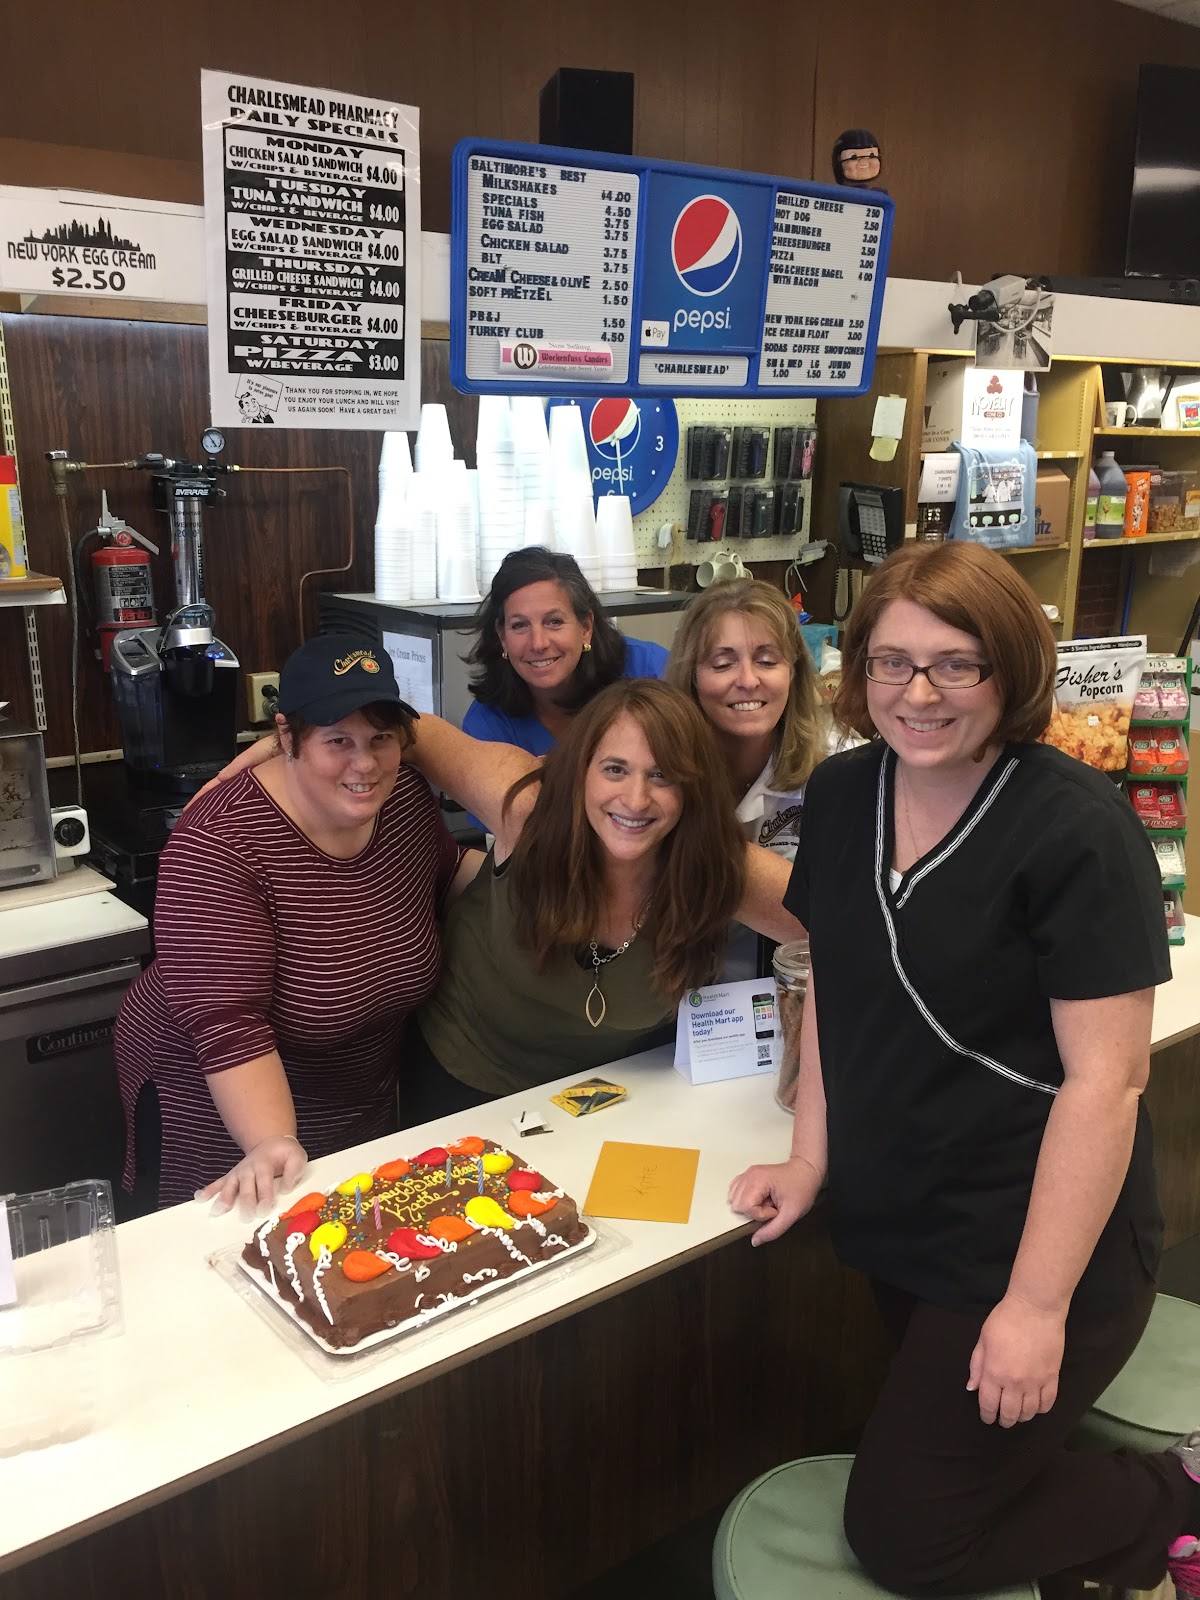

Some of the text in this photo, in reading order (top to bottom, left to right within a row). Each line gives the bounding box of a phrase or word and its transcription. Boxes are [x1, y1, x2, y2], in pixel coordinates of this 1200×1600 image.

[228, 85, 398, 128] CHARLESMEAD PHARMACY
[230, 107, 398, 142] DAILY SPECIALS
[266, 136, 364, 158] MONDAY
[229, 145, 398, 184] CHICKEN SALAD SANDWICH $4.00
[231, 160, 362, 183] W/CHIPS BEVERAGE
[472, 159, 586, 182] BALTIMORE'S BEST
[265, 177, 366, 199] TUESDAY
[482, 174, 557, 195] MILKSHAKES
[231, 186, 399, 222] TUNA SANDWICH $4.00
[231, 202, 363, 222] W/CHIPS BEVERAGE
[482, 192, 631, 218] SPECIALS 4.50
[778, 195, 844, 214] GRILLED CHEESE
[483, 206, 629, 230] TUNA FISH 3.75
[775, 208, 790, 220] HOT
[794, 211, 810, 222] DOG
[250, 216, 384, 238] WEDNESDAY
[482, 218, 628, 242] EGG SALAD 3.75
[774, 222, 822, 238] HAMBURGER
[232, 229, 399, 260] EGG SALAD SANDWICH $4.00
[232, 242, 362, 260] W/CHIPS BEVERAGE
[481, 234, 628, 259] CHICKEN SALAD 3.75
[772, 236, 831, 252] CHEESEBURGER
[7, 242, 156, 270] NEW YORK EGG CREAM
[482, 252, 628, 274] BLT 3.75
[771, 250, 794, 261] PIZZA
[259, 256, 380, 276] THURSDAY
[822, 268, 844, 279] BAGEL
[52, 266, 126, 292] $2.50
[232, 268, 400, 298] GRILLED CHEESE SANDWICH $4.00
[468, 267, 506, 283] CREAM
[602, 280, 628, 292] 2.50
[773, 274, 819, 288] WITH BACON
[233, 282, 363, 298] W/CHIPS BEVERAGE
[469, 286, 628, 306] SOFT PRETZEL 1.50
[280, 298, 362, 312] FRIDAY
[234, 308, 398, 334] CHEESEBURGER $4.00
[234, 320, 362, 334] W/CHIPS BEVERAGE
[469, 310, 625, 328] PB&J 1.50
[674, 307, 730, 333] pepsi
[765, 314, 864, 328] NEW YORK EGG CREAM 2.50
[261, 334, 379, 350] SATURDAY
[468, 326, 624, 342] TURKEY CLUB 4.50
[652, 328, 666, 340] Pay
[764, 327, 778, 336] ICE
[780, 328, 806, 338] CREAM
[808, 330, 830, 339] FLOAT
[764, 342, 820, 354] SODAS COFFEE
[234, 345, 398, 372] PIZZA $3.00
[246, 360, 354, 372] W/BEVERAGE
[542, 353, 582, 362] Wockenfuss
[787, 359, 802, 368] MED
[810, 360, 820, 368] LG
[828, 360, 852, 369] JUMBO
[772, 369, 846, 379] 1.00 1.50 2.50
[286, 386, 306, 394] THANK
[655, 436, 664, 452] 3
[592, 466, 633, 484] pepsi
[412, 650, 426, 663] Prices
[1056, 662, 1123, 690] Fisher's
[1080, 684, 1124, 699] Popcorn
[691, 1009, 724, 1020] Download
[692, 1020, 714, 1028] Health
[732, 1016, 744, 1024] app
[692, 1028, 713, 1036] today!
